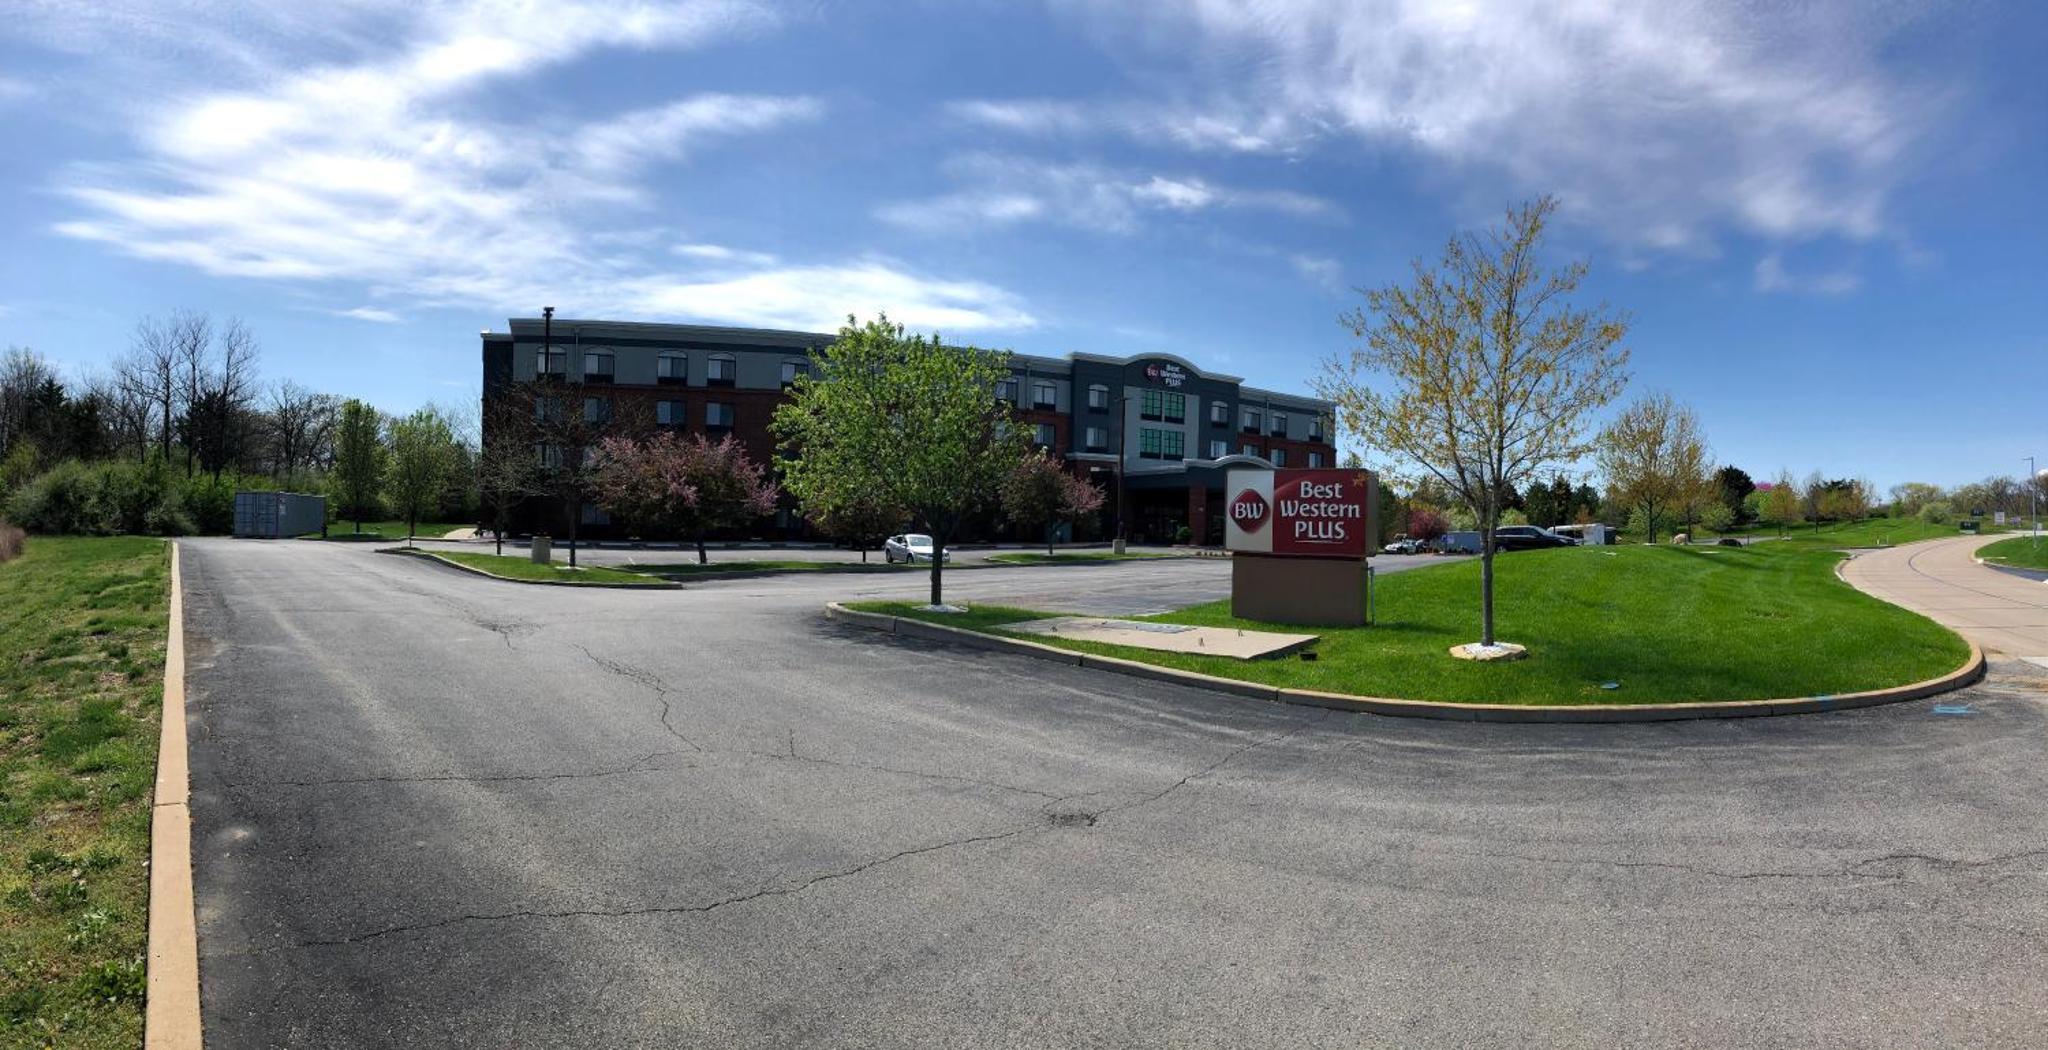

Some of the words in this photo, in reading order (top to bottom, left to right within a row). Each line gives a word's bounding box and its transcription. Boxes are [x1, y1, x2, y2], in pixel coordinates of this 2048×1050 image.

[1300, 480, 1343, 499] Best
[1234, 502, 1264, 519] BW
[1280, 500, 1361, 518] Western
[1295, 521, 1345, 539] PLUS
